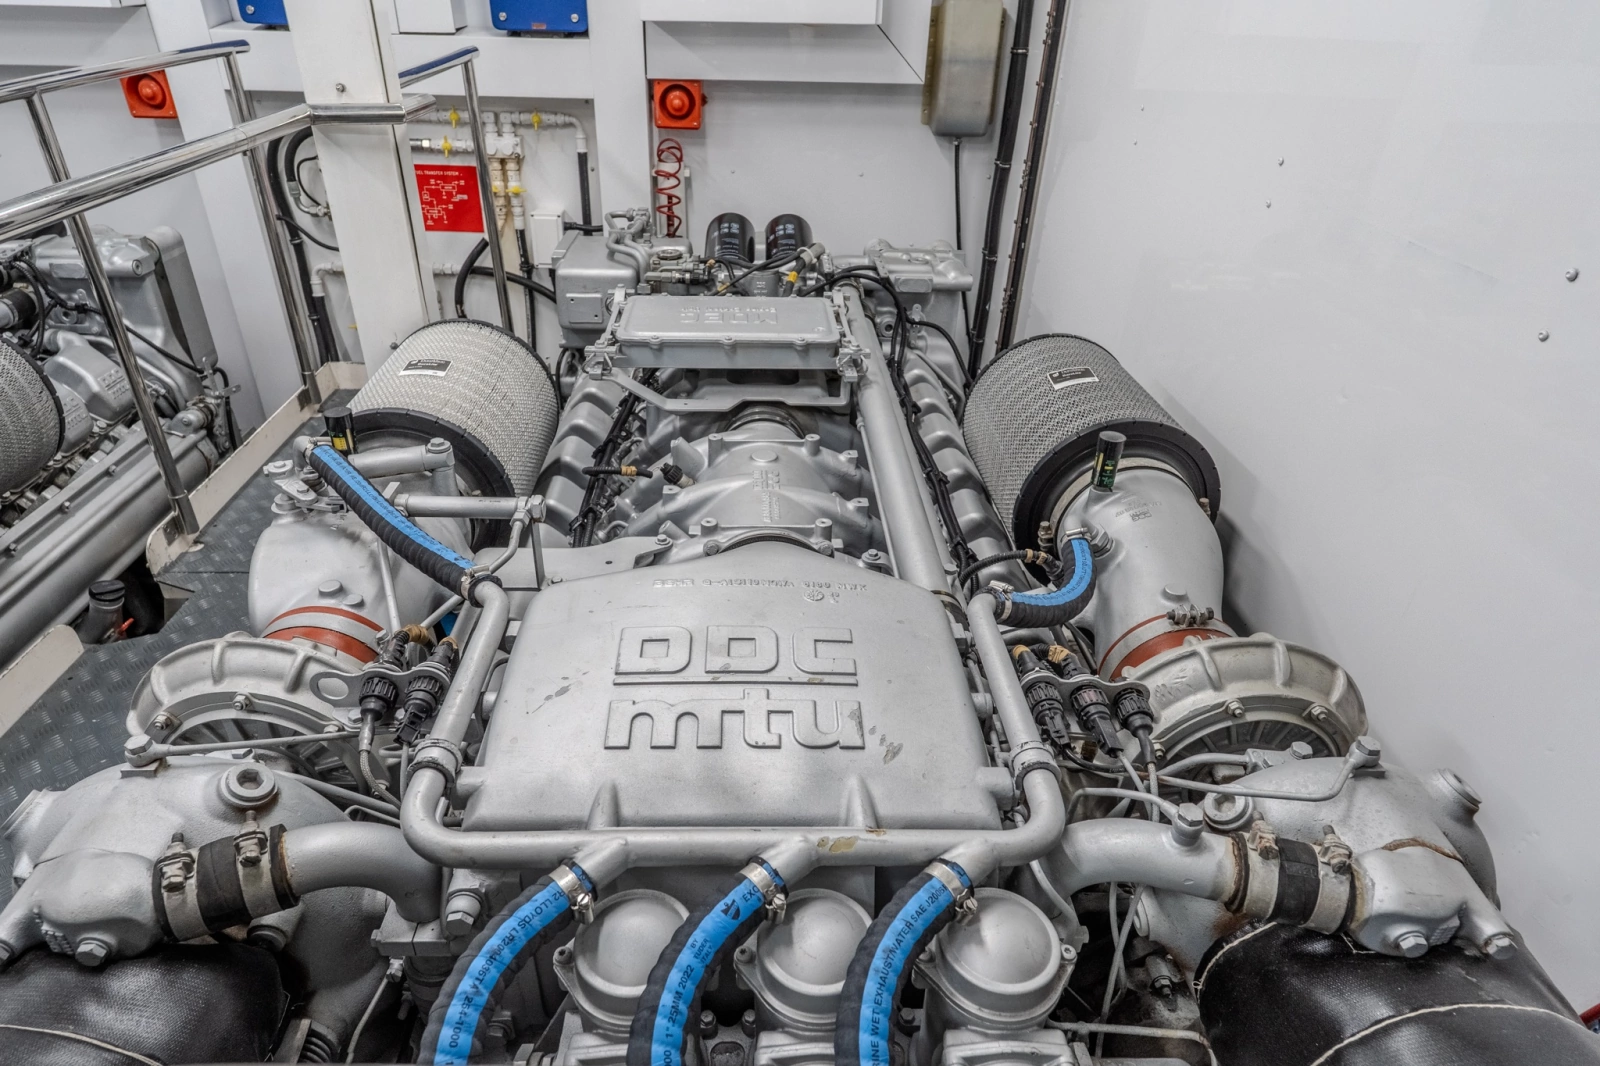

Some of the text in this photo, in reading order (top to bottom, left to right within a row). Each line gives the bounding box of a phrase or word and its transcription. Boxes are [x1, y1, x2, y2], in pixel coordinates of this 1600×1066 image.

[614, 625, 858, 676] DDC
[603, 688, 866, 750] mtu
[518, 898, 556, 930] LLOYDS
[689, 939, 699, 949] BY
[693, 938, 710, 960] TUDER
[667, 990, 684, 1026] 25MM
[677, 964, 695, 989] 2022
[870, 1009, 880, 1036] WET
[910, 905, 927, 923] SAE
